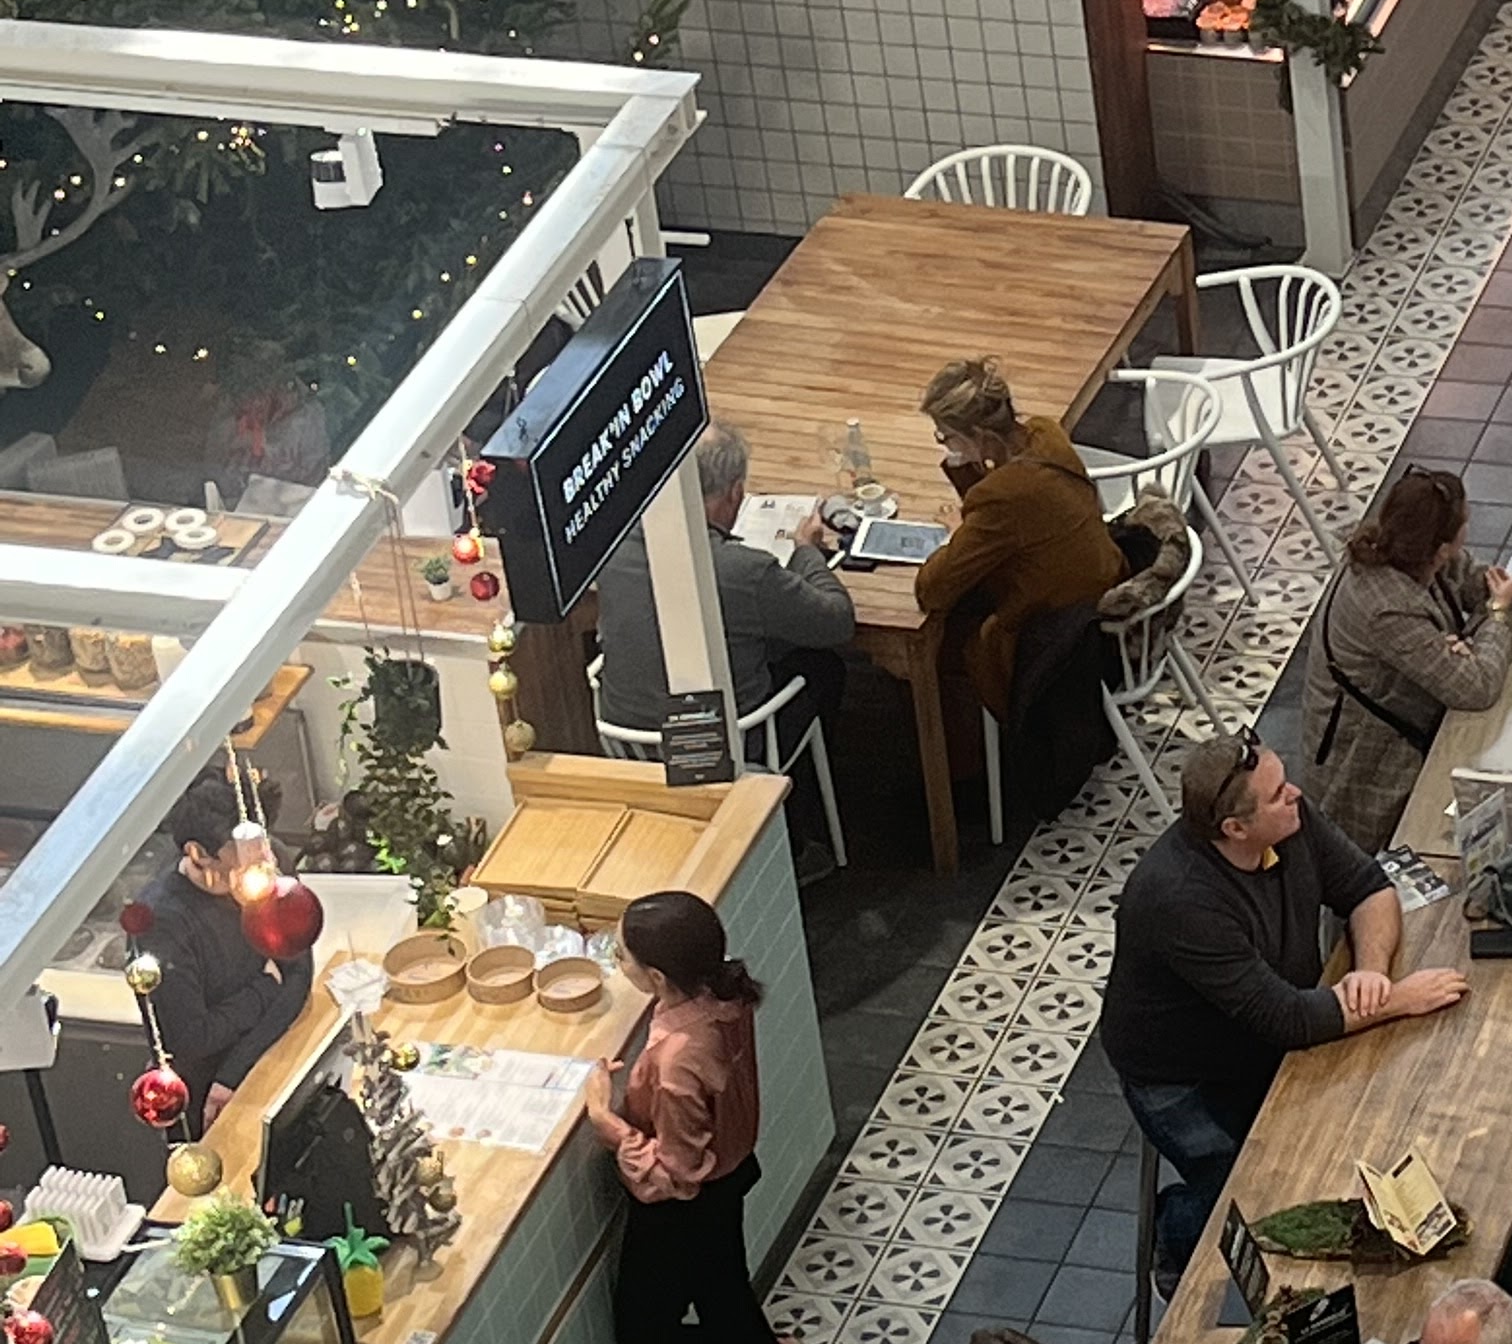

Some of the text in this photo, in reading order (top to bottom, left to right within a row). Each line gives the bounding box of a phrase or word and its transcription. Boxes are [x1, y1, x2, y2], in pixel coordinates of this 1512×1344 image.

[562, 349, 674, 504] BREAK'IN BOWL
[563, 377, 686, 544] HEALTHY SNACKING
